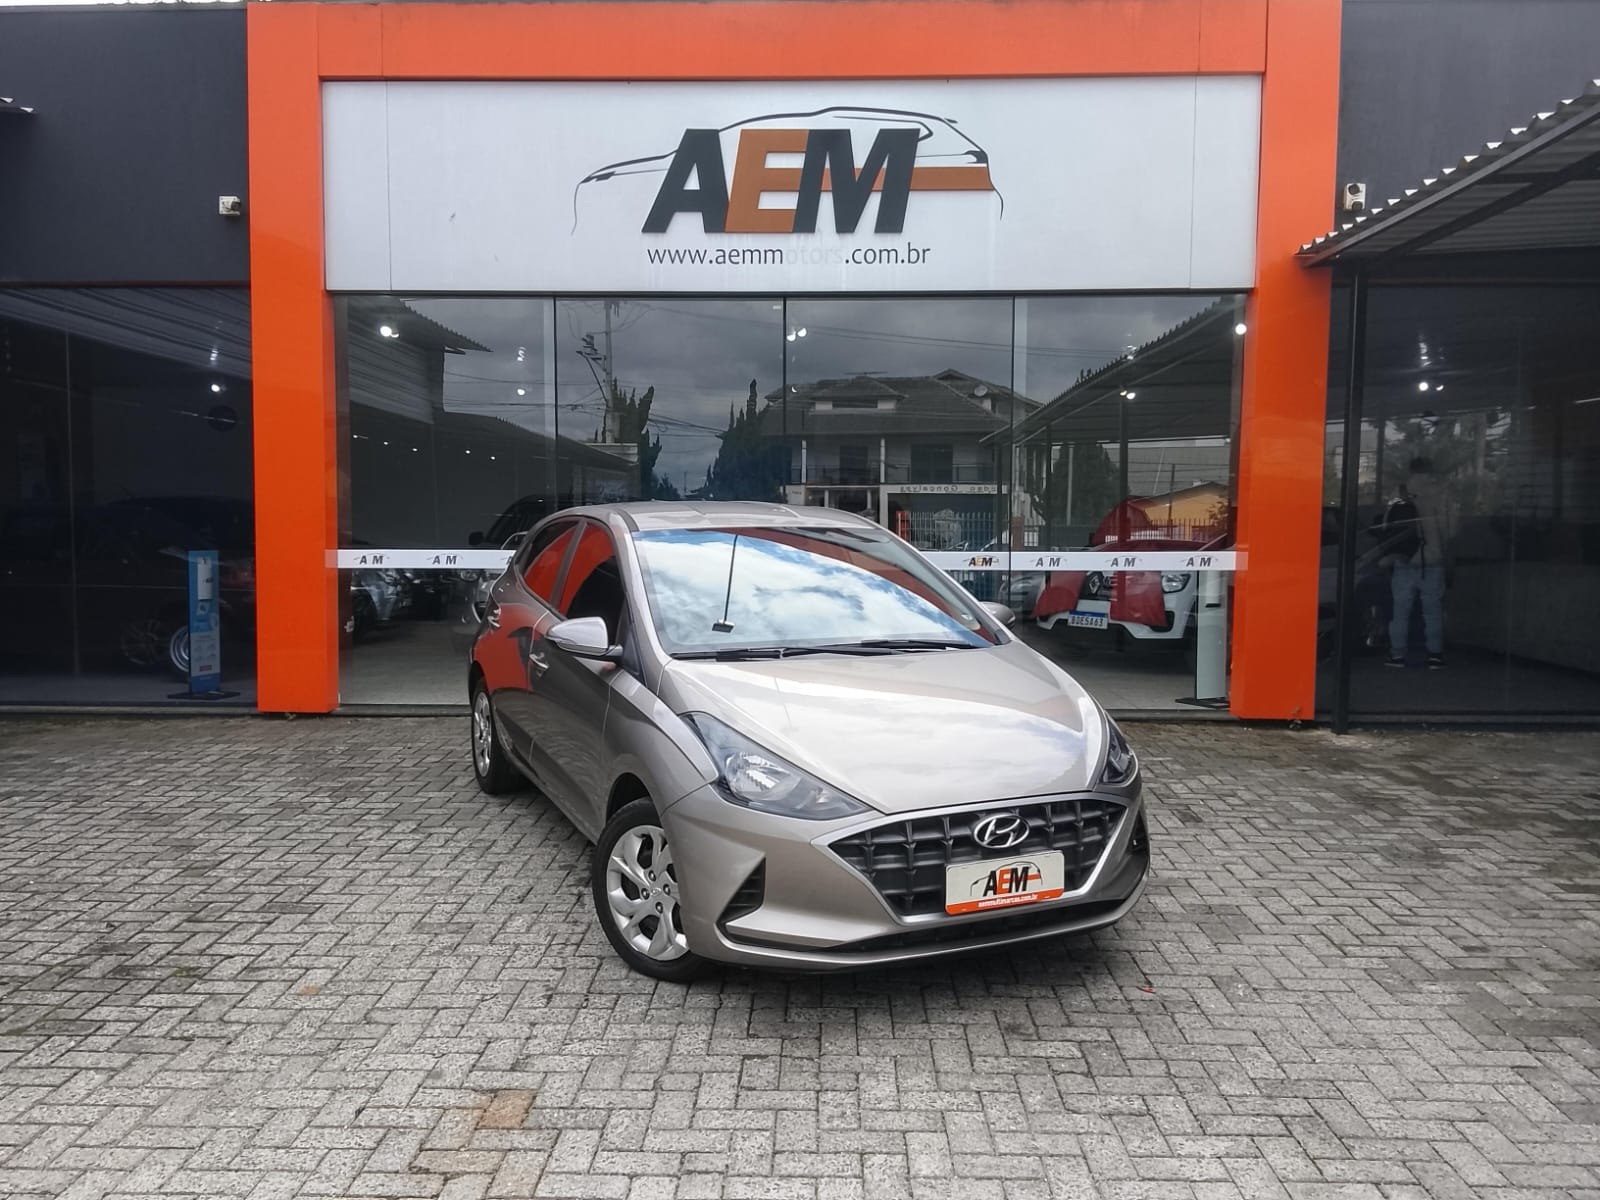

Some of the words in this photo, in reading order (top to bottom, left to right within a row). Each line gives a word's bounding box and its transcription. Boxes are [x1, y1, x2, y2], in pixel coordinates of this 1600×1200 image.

[642, 128, 920, 233] AEM
[968, 557, 993, 567] AEM
[983, 866, 1029, 897] AEM
